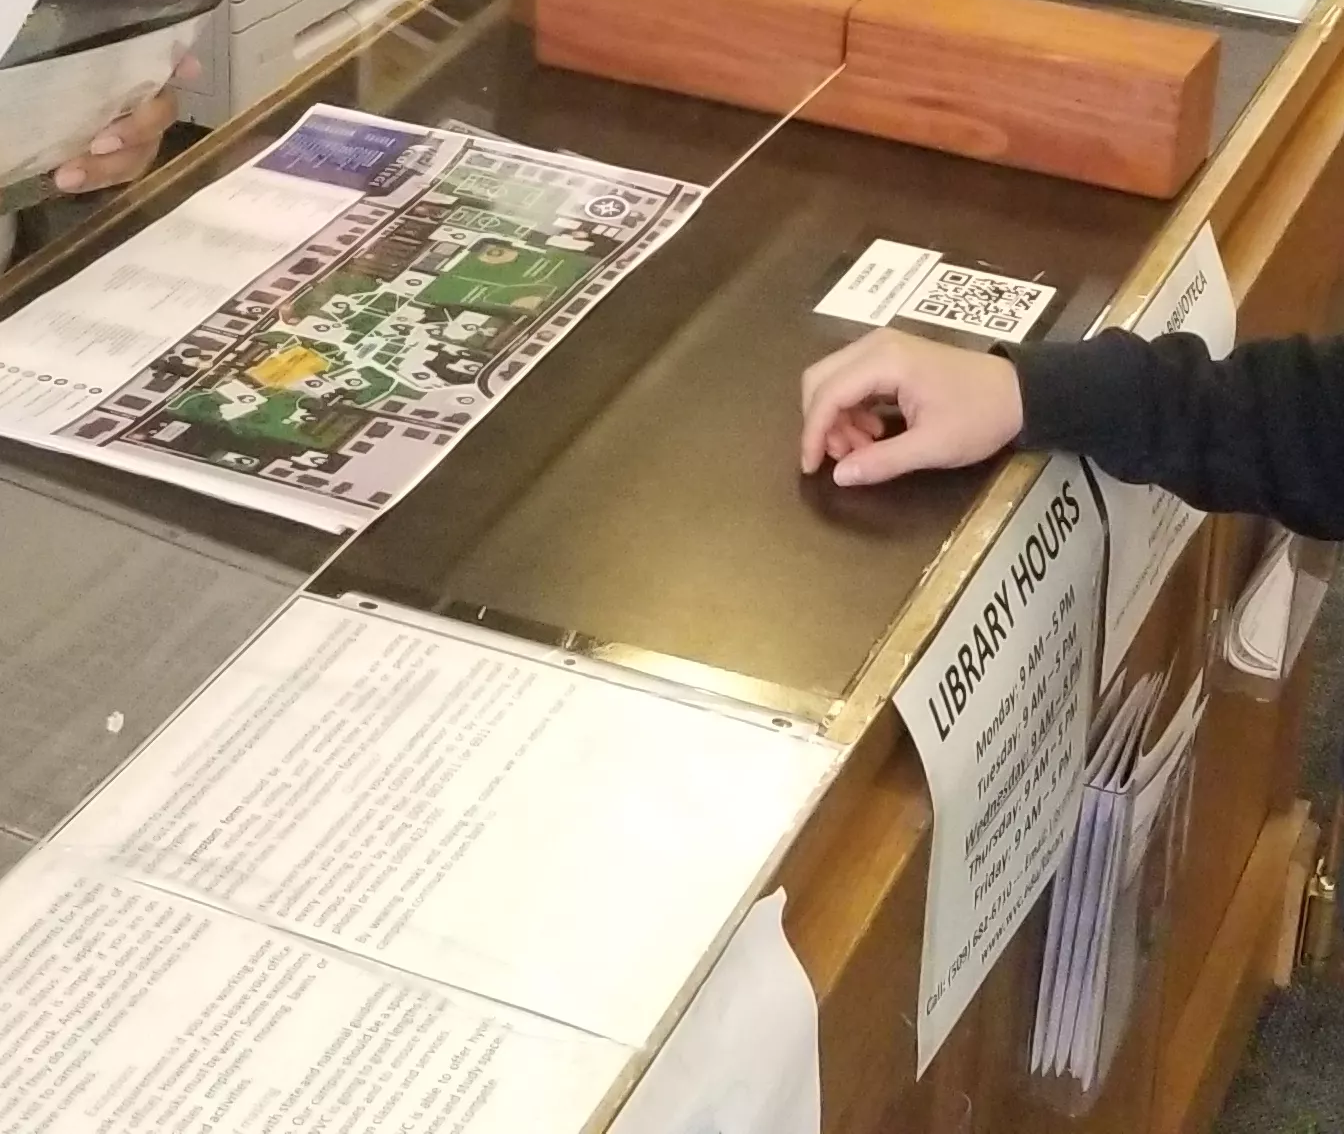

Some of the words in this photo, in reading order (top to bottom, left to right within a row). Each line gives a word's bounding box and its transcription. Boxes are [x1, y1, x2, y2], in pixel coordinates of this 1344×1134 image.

[1166, 269, 1208, 334] BIBLIOTECA
[928, 578, 1014, 743] LIBRARY
[1010, 479, 1081, 608] HOURS
[976, 684, 1019, 764] Monday:
[1020, 666, 1026, 691] 9
[1028, 635, 1044, 677] AM
[1052, 610, 1059, 636] 5
[1059, 584, 1075, 623] PM
[965, 750, 1029, 856] Wednesday:
[1031, 730, 1037, 755] 9
[1039, 699, 1055, 741] AM
[969, 795, 1022, 882] Thursday:
[1024, 778, 1031, 802] 9
[1032, 748, 1049, 789] AM
[1058, 721, 1064, 746] 5
[1065, 693, 1078, 734] PM
[977, 722, 1021, 802] Tuesday:
[1022, 706, 1029, 729] 9
[1031, 675, 1047, 717] AM
[1055, 650, 1061, 674] 5
[1063, 622, 1077, 661] PM
[973, 845, 1011, 911] Friday:
[1014, 828, 1022, 852] 9
[1023, 796, 1042, 841] AM
[1051, 770, 1057, 795] 5
[1058, 739, 1072, 779] PM
[926, 980, 946, 1016] Call:
